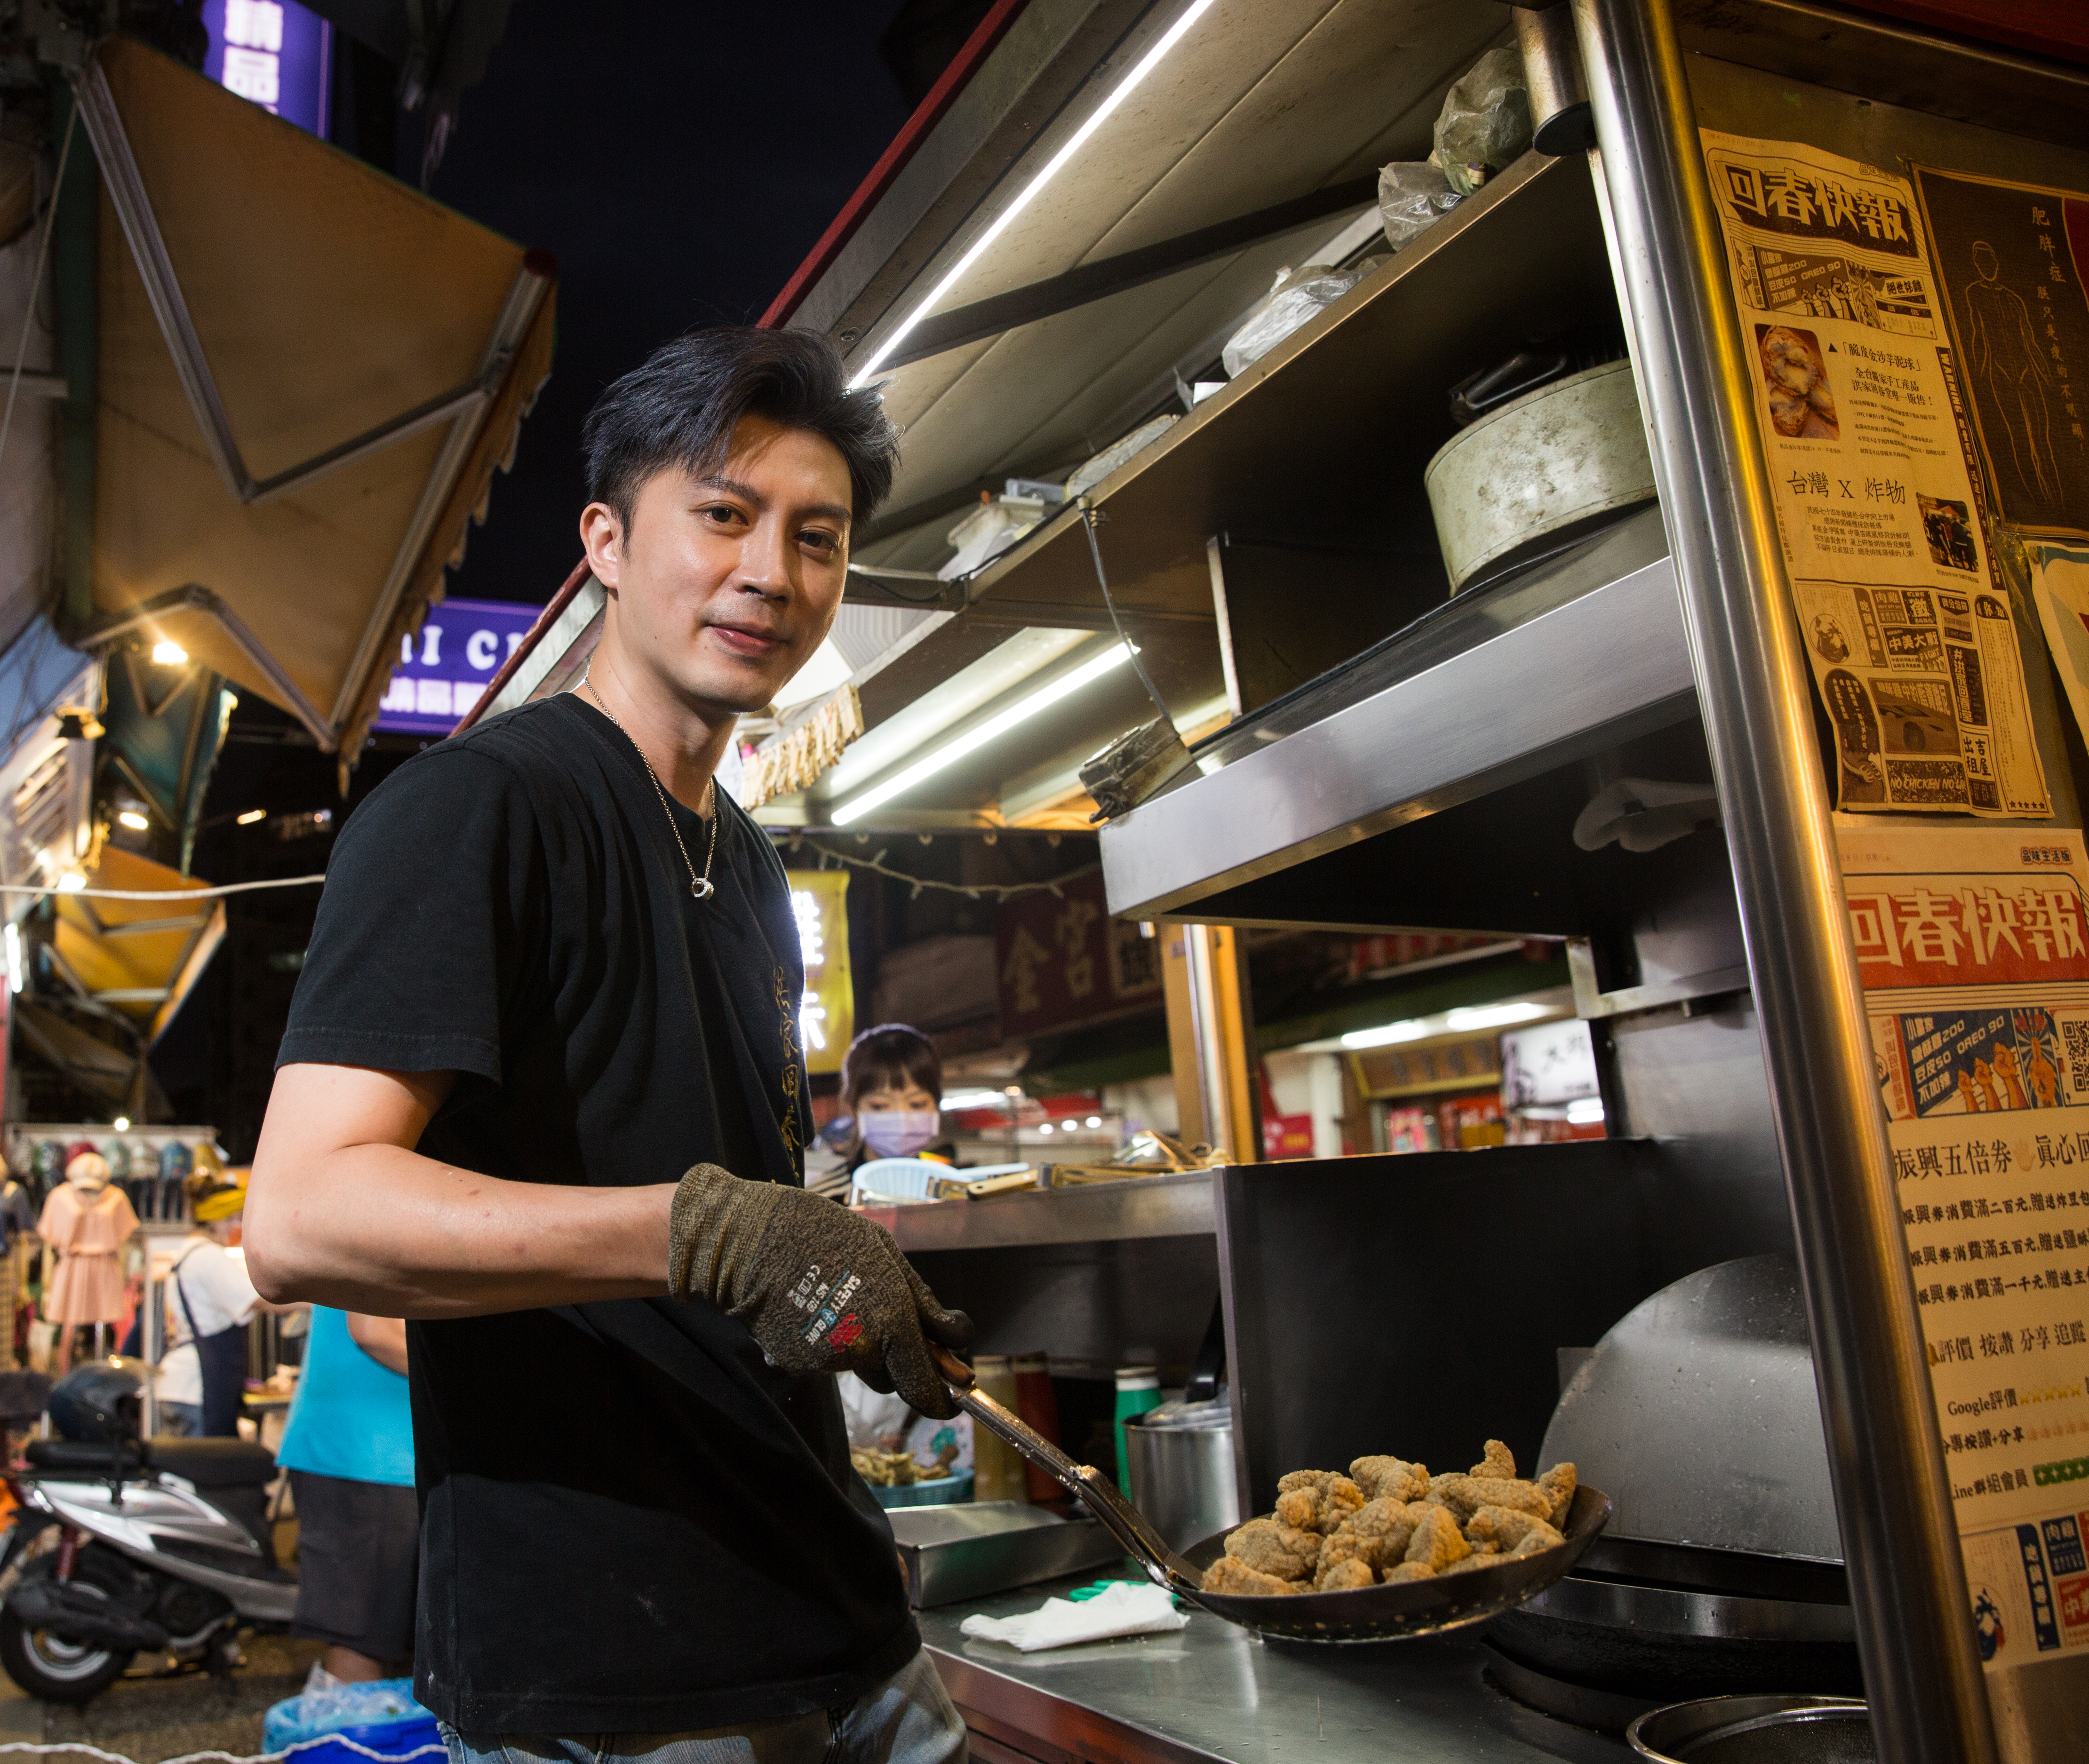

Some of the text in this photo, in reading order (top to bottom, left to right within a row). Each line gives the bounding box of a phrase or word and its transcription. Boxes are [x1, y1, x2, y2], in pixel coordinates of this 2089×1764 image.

[1715, 160, 1908, 242] 回春快報
[2032, 206, 2067, 282] 肥胖症
[1800, 266, 1826, 280] OREO
[1827, 261, 1841, 272] 90
[1940, 352, 1962, 413] WARNING
[1786, 470, 1906, 504] 台灣 X 炸物
[1889, 631, 1939, 651] 中美大戰
[1919, 648, 1940, 661] FIGHT
[1890, 777, 1902, 790] NO
[1942, 778, 1954, 790] NO
[2022, 848, 2072, 864] 品味生活版
[1847, 887, 2086, 967] 回春快報
[1957, 1027, 1985, 1055] OREO
[1988, 1015, 2005, 1034] 90
[1917, 1071, 1952, 1105] 不加辣
[1893, 1139, 2012, 1182] 振興五倍券
[805, 1275, 861, 1345] SAFETY GLOVE
[1939, 1335, 1974, 1363] 評價
[2020, 1325, 2050, 1352] 分享
[2054, 1320, 2086, 1346] 追蹤
[1947, 1388, 2018, 1416] Google評價
